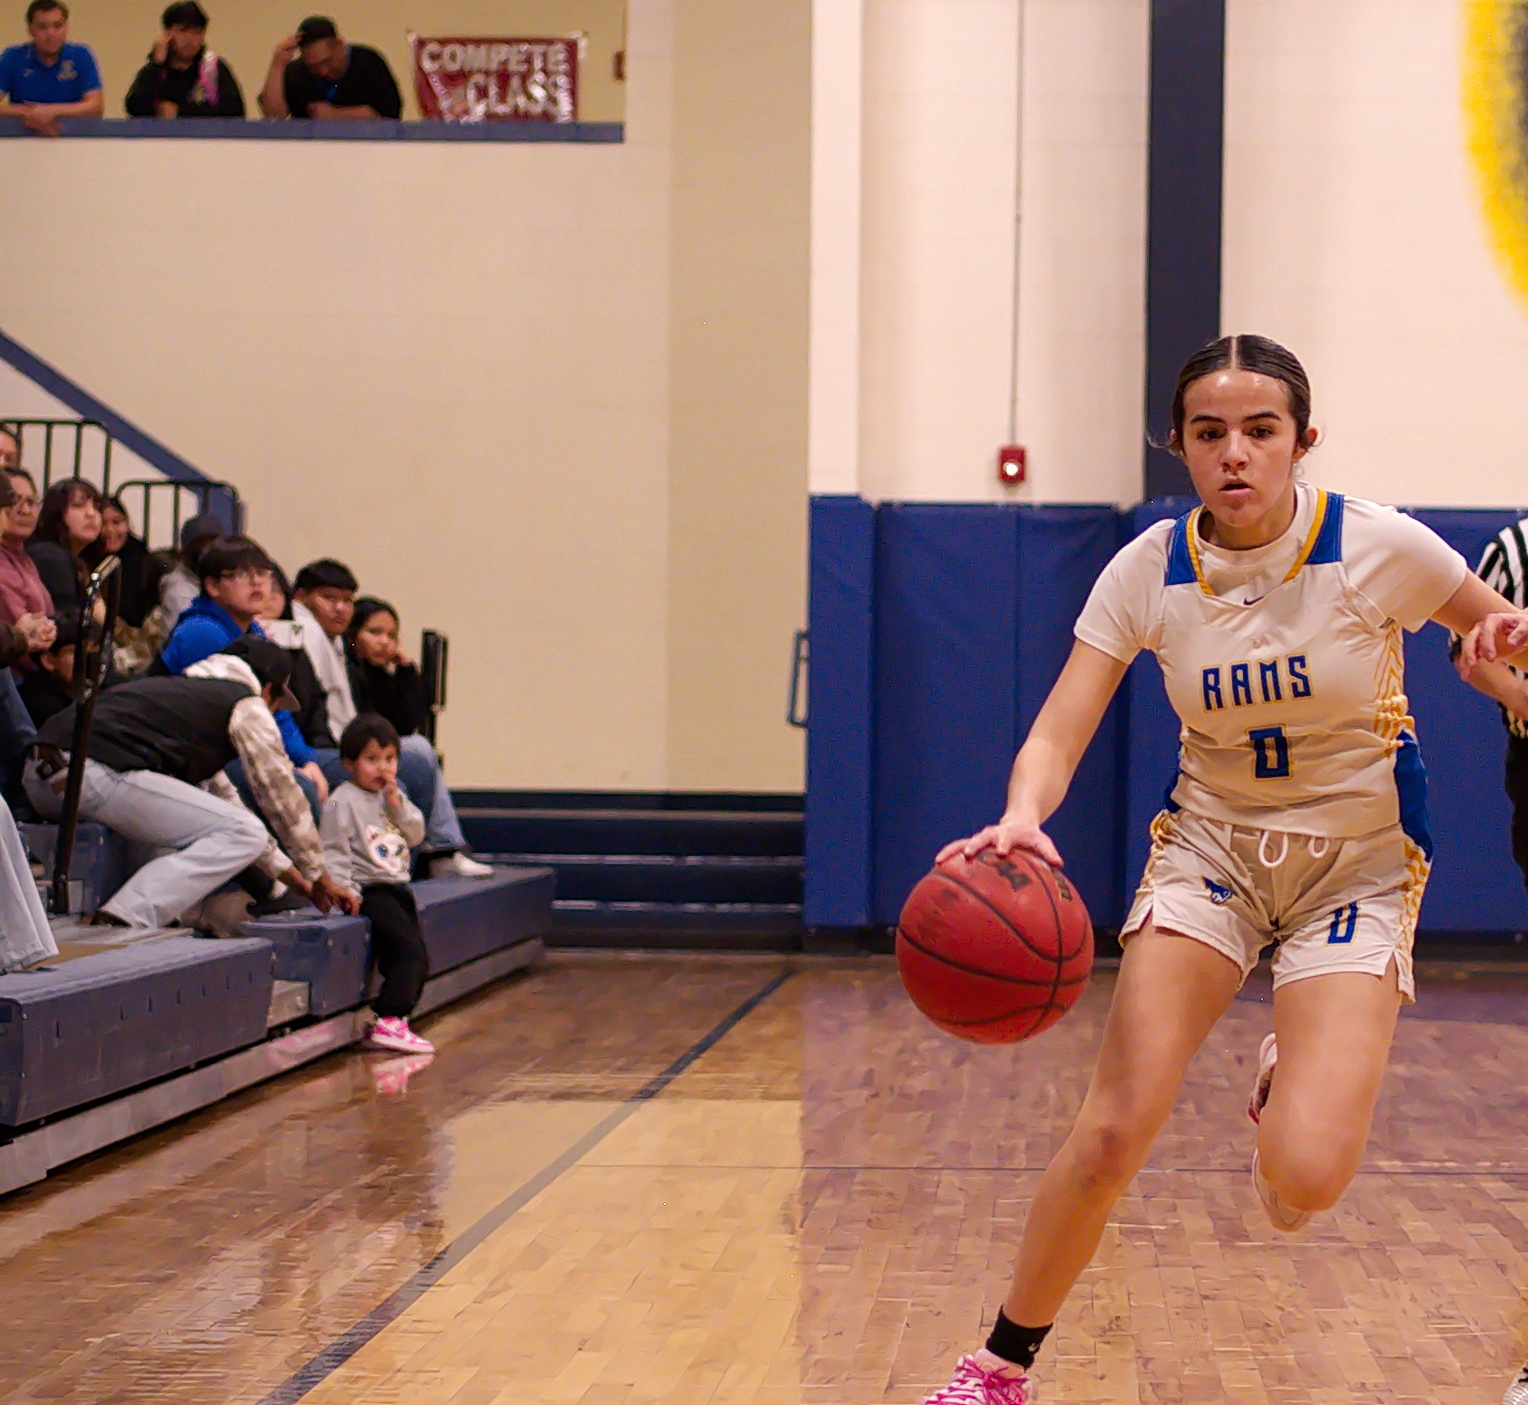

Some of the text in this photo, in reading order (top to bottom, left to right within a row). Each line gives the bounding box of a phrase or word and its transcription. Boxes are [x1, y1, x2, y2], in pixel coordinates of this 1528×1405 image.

[420, 42, 570, 74] COMPETE
[466, 71, 574, 122] CLASS
[1201, 651, 1315, 713] RAMS
[1246, 723, 1294, 782] 0
